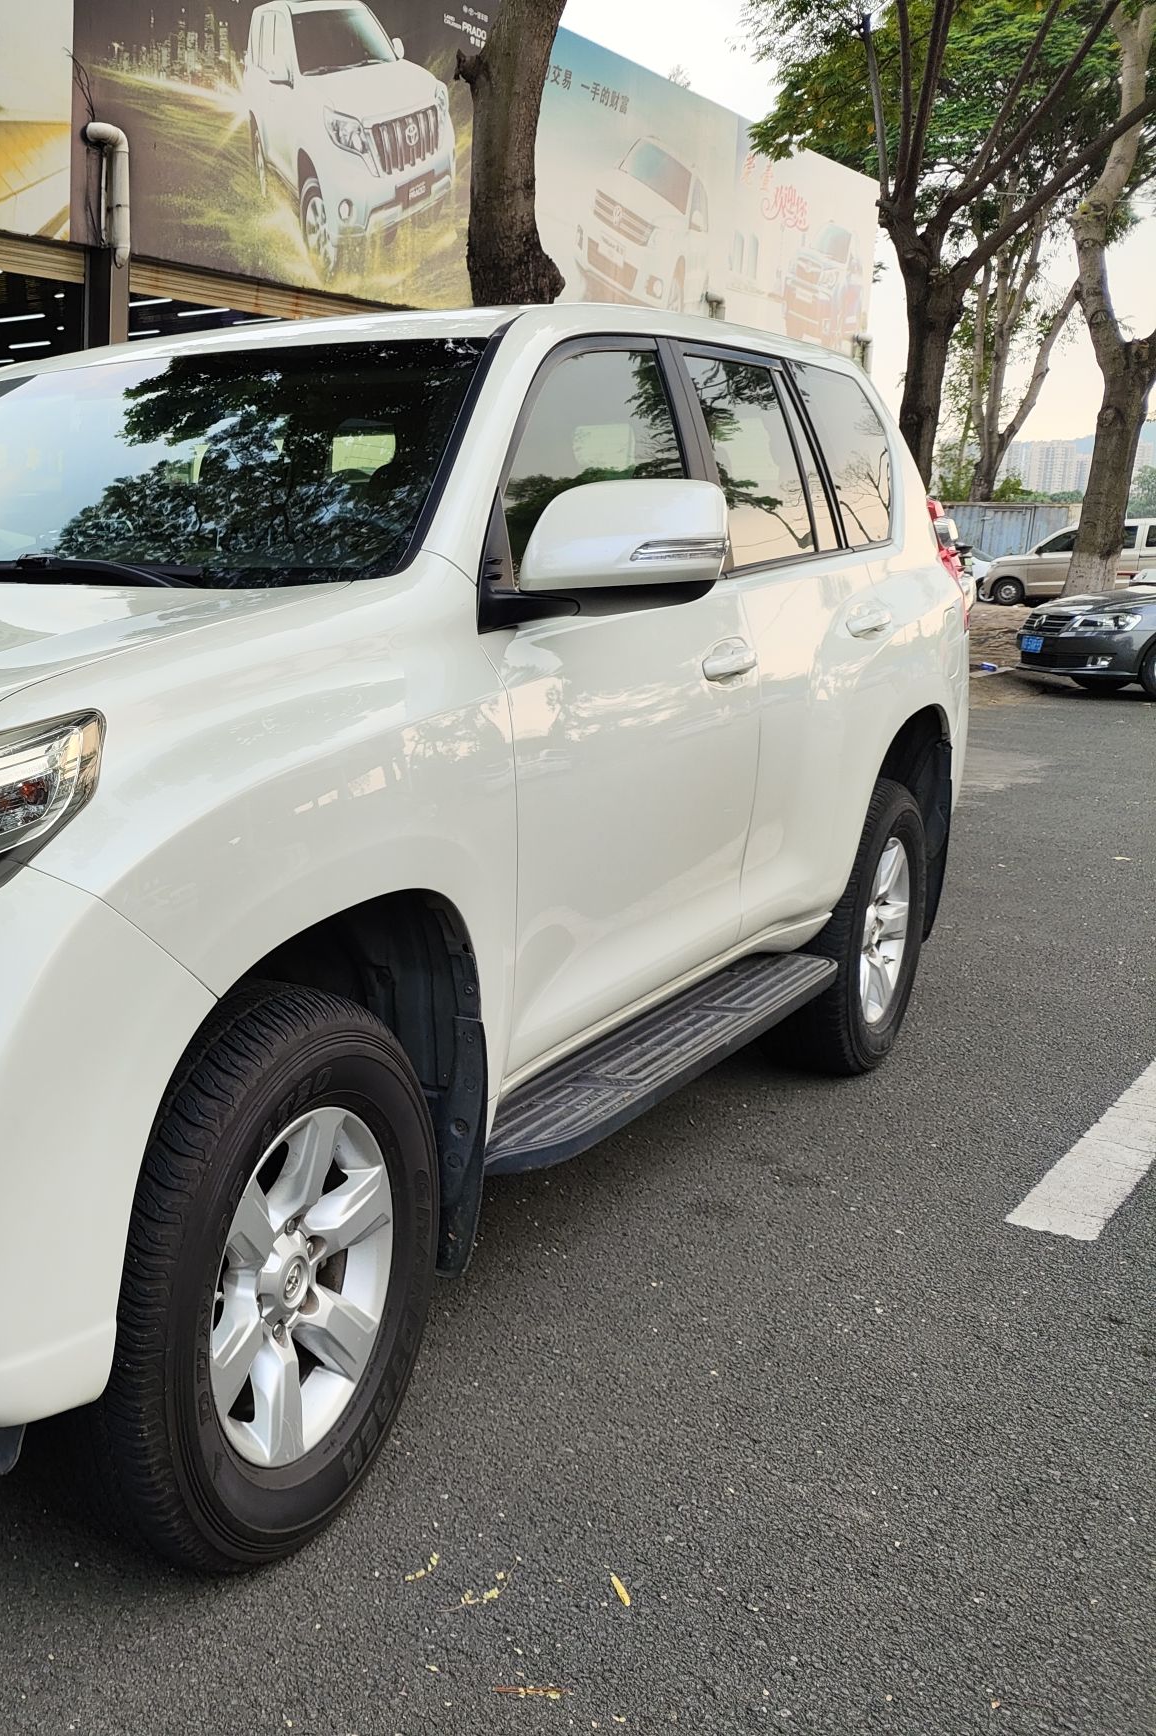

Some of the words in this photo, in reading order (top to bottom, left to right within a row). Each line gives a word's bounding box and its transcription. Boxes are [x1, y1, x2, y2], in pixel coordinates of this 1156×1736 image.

[461, 21, 487, 41] PRADO
[580, 81, 630, 115] 一手的财富
